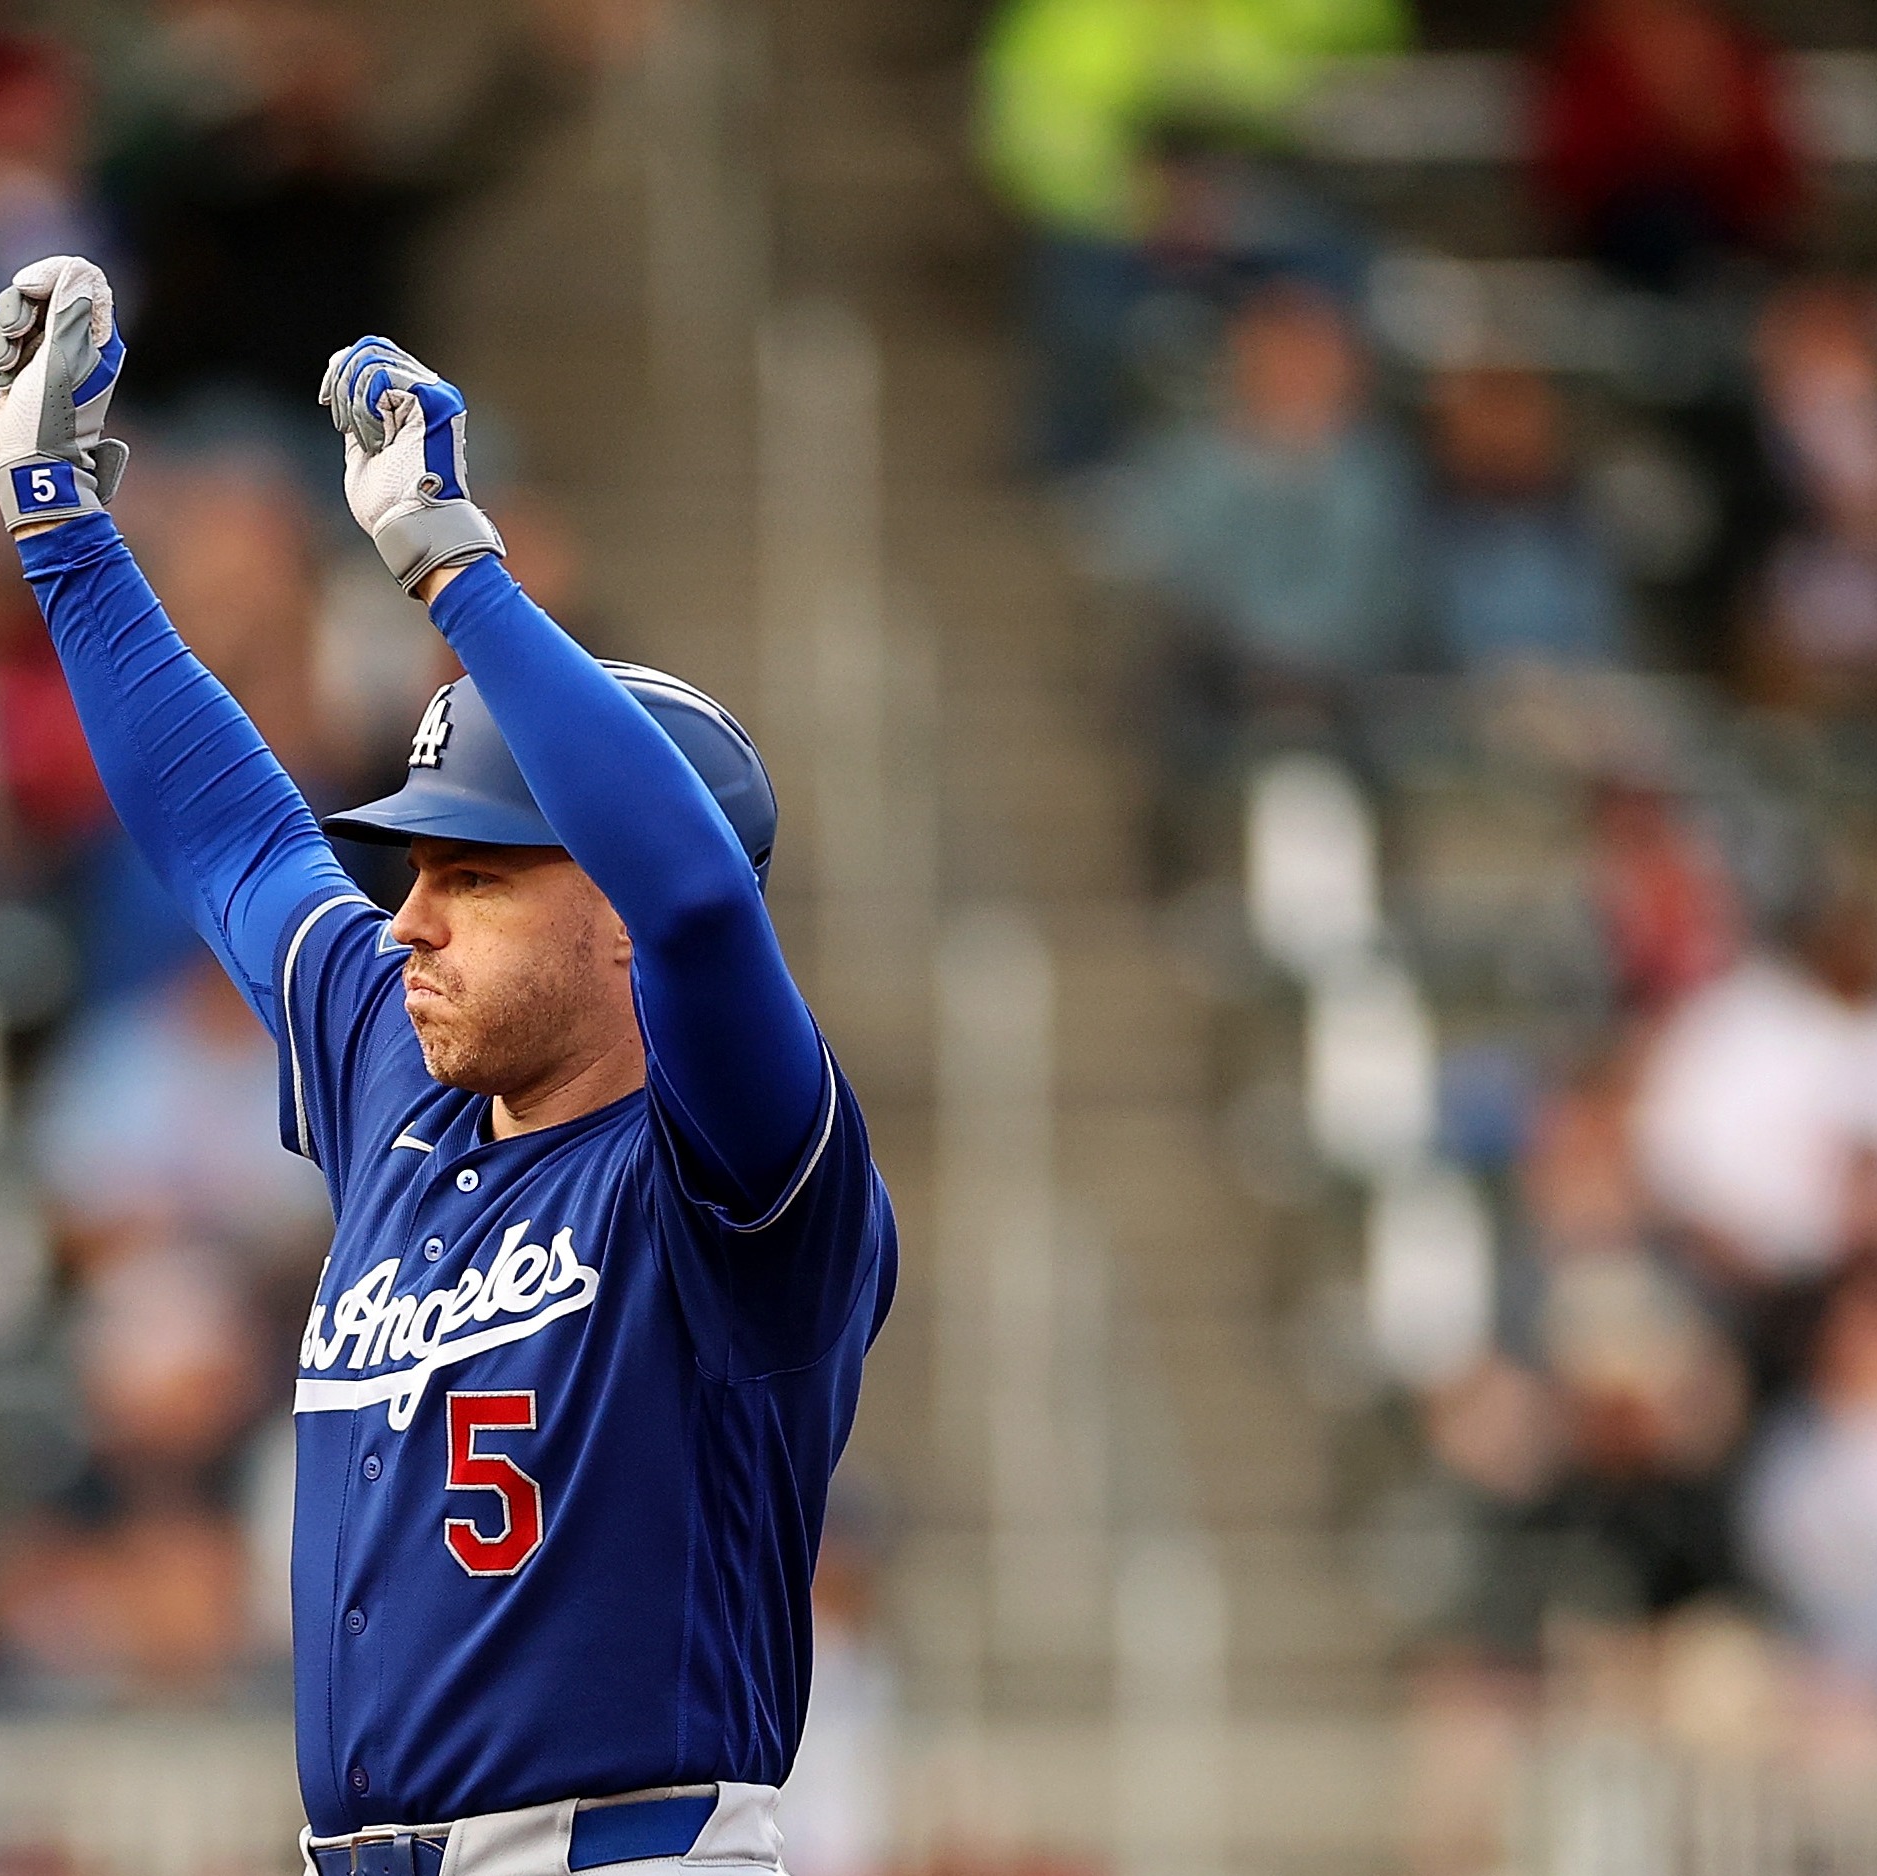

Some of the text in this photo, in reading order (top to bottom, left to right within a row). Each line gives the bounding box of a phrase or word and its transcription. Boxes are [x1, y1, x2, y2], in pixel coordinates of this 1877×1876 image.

[30, 468, 57, 503] 5
[408, 684, 452, 767] LA
[314, 1219, 600, 1431] Angeles
[444, 1389, 543, 1577] 5
